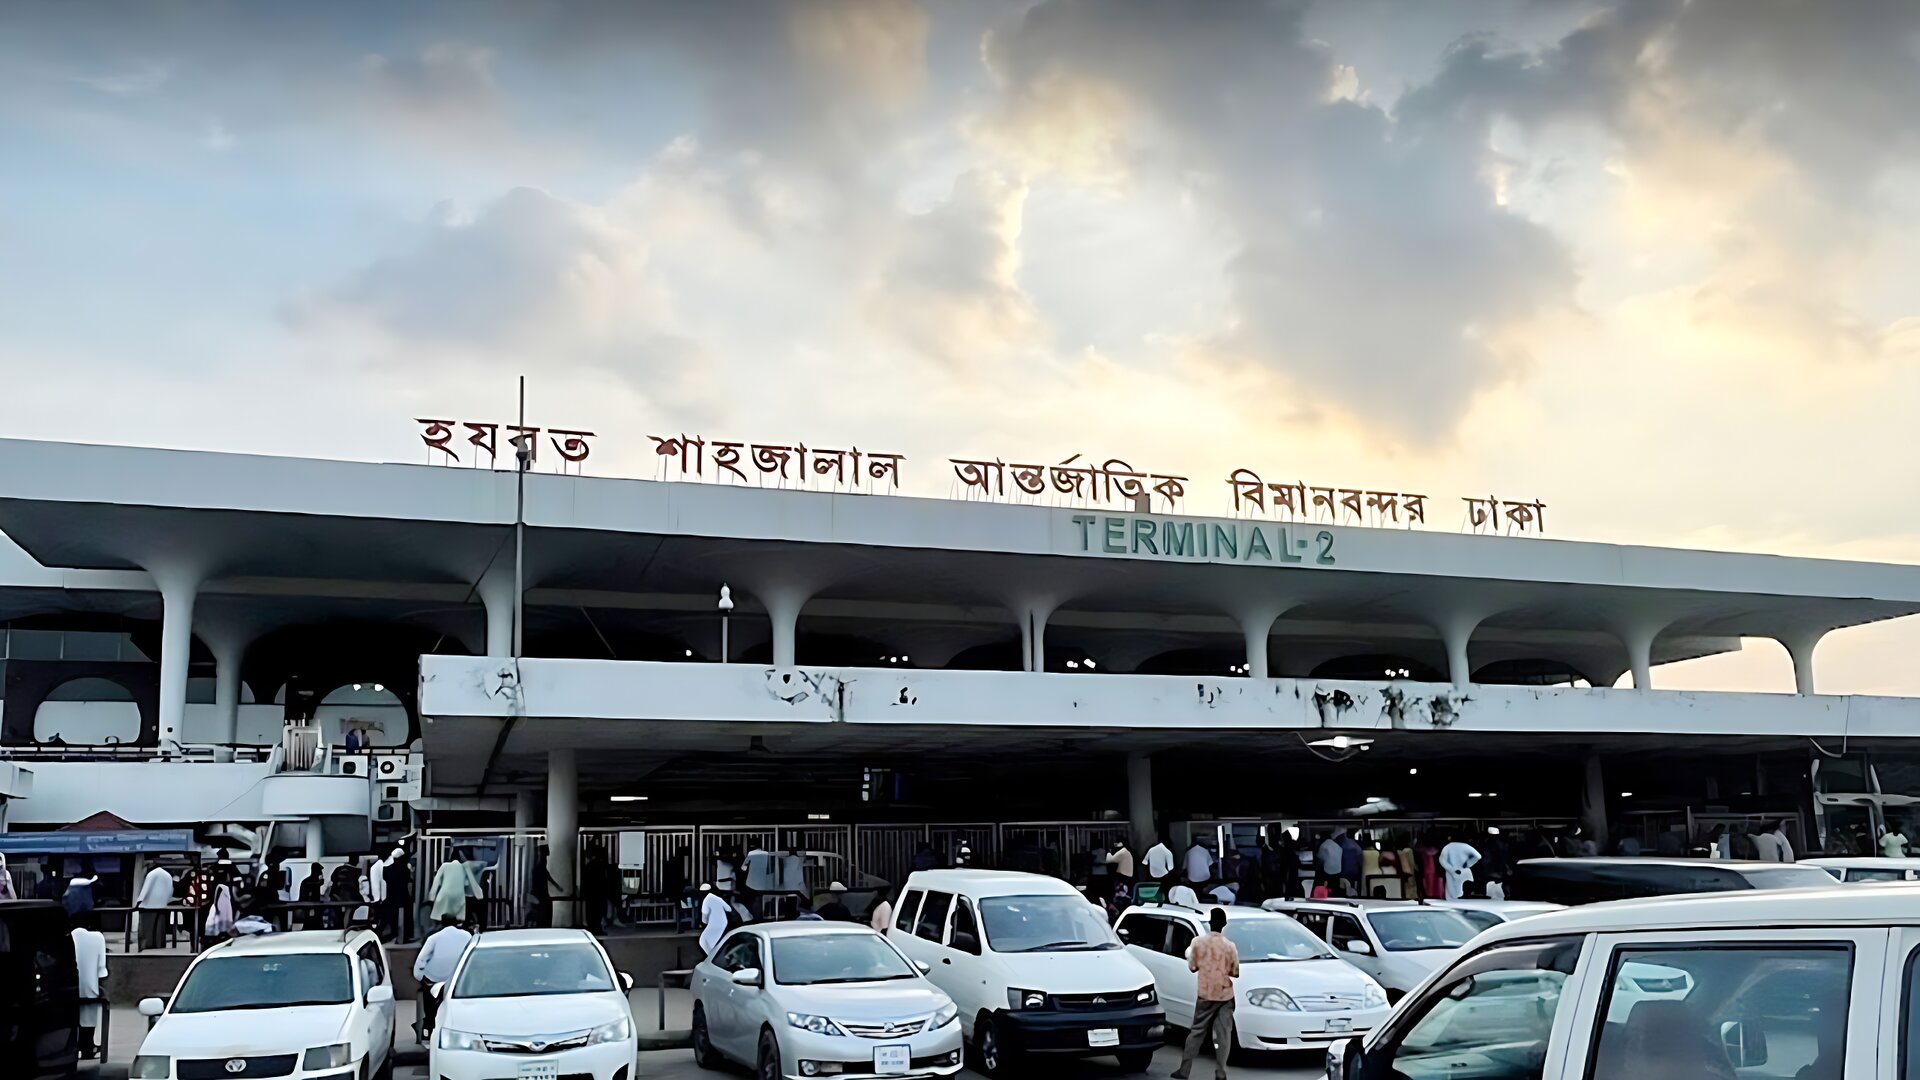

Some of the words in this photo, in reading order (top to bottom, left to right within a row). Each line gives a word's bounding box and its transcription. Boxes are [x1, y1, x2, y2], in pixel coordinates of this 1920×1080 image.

[646, 433, 906, 488] শাহজালাল
[949, 454, 1189, 507] আন্তর্জাতিক
[1225, 468, 1429, 524] বিমানবন্দর
[1461, 495, 1546, 532] ঢাকা
[1072, 515, 1336, 565] TERMINAL-2
